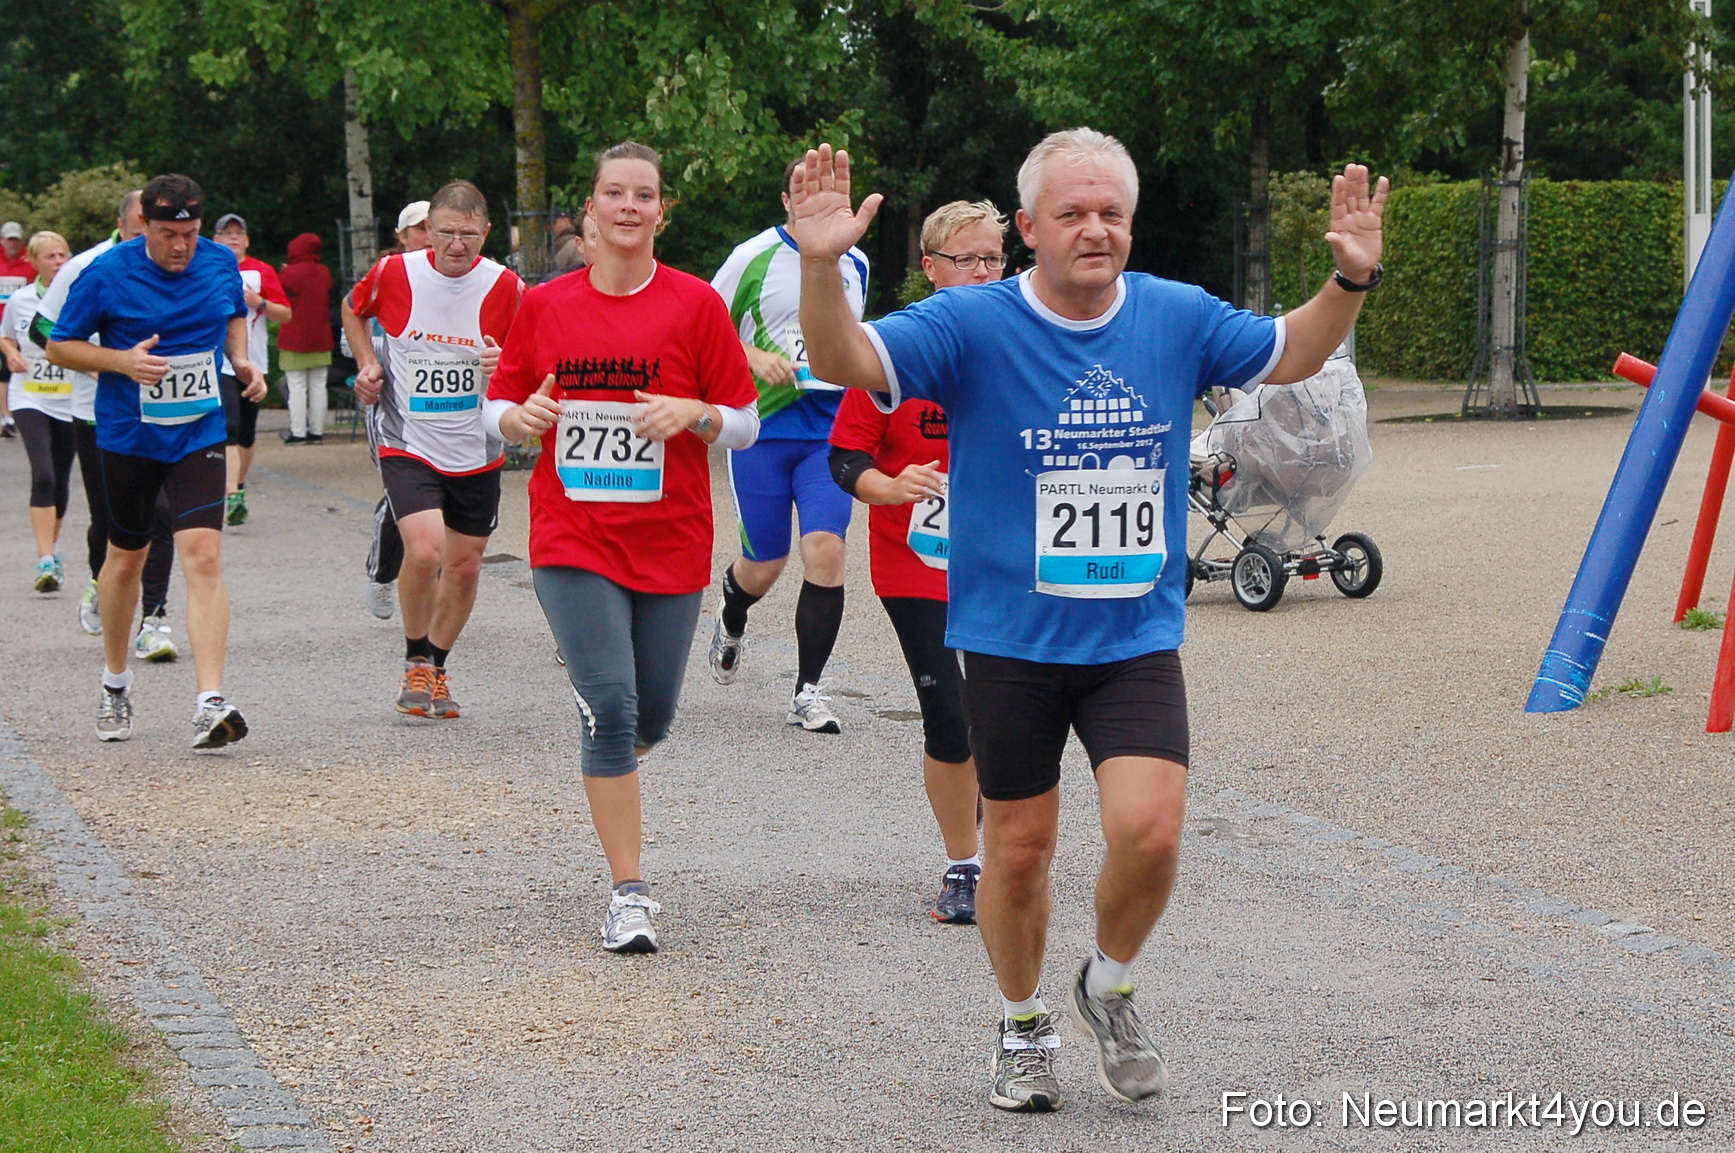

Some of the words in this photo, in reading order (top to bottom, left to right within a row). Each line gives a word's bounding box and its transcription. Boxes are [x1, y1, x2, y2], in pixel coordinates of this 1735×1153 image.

[426, 333, 478, 348] KLEBL
[149, 370, 211, 399] 3124
[415, 368, 475, 394] 2698
[560, 373, 580, 387] RUN
[583, 371, 605, 387] FOR
[424, 400, 464, 410] Manfred
[561, 411, 592, 420] ARTL
[924, 421, 948, 435] RUN
[565, 426, 654, 462] 2732
[1020, 428, 1060, 450] 13.
[1054, 428, 1126, 439] Neumarkter
[1077, 440, 1134, 450] 16.September
[1135, 438, 1154, 447] 2012
[584, 472, 633, 486] Nadine
[1040, 484, 1085, 494] PARTL
[1089, 483, 1147, 494] Neumarkt
[1052, 501, 1154, 548] 2119
[1086, 562, 1125, 579] Rudi
